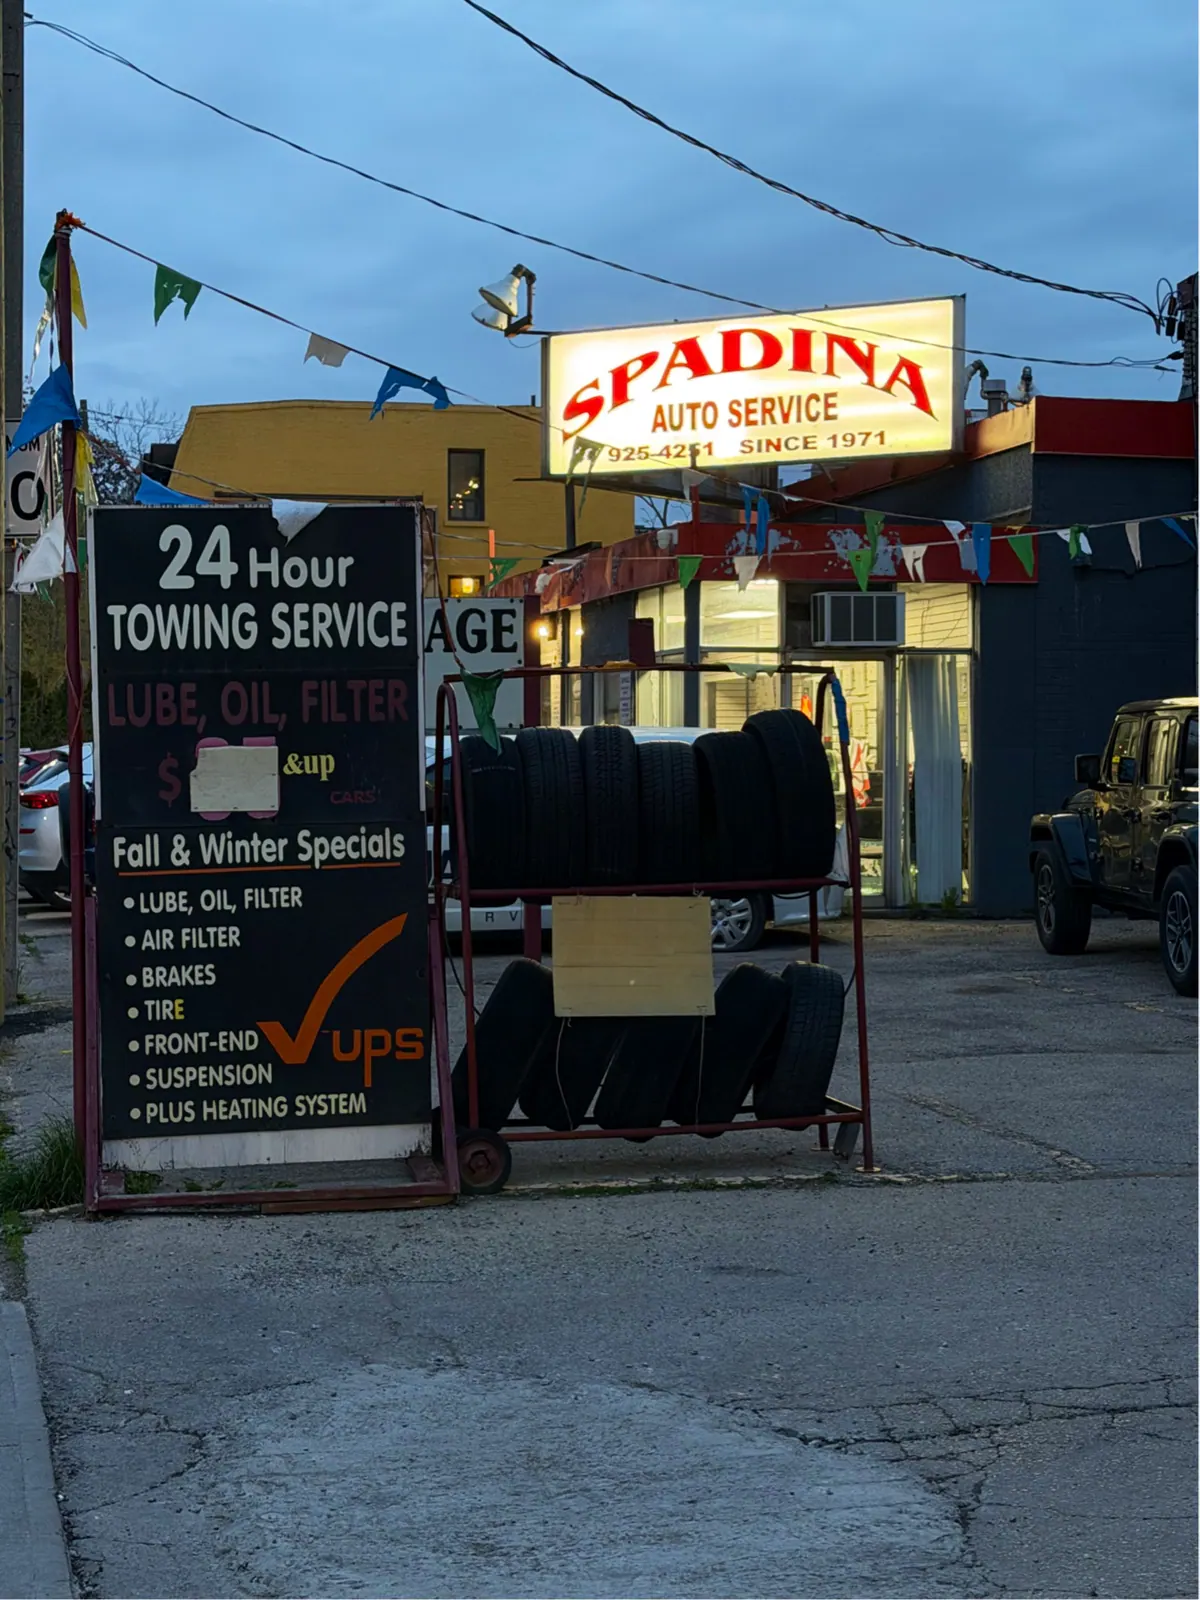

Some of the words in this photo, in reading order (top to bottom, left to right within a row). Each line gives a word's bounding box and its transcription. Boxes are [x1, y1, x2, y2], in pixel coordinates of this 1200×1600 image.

[562, 328, 938, 442] SPADINA
[651, 402, 718, 433] AUTO
[727, 392, 838, 428] SERVICE
[740, 437, 817, 454] SINCE
[831, 430, 886, 449] 1971
[159, 524, 239, 590] 24
[249, 547, 354, 589] Hour
[107, 603, 258, 651] TOWING
[272, 601, 407, 648] SERVICE
[108, 682, 207, 733] LUBE,
[221, 681, 287, 731] OIL,
[302, 679, 409, 723] FILTER
[330, 790, 377, 805] CARS
[113, 833, 160, 868] Fall
[170, 833, 190, 866] &
[199, 831, 288, 865] Winter
[298, 826, 405, 869] Specials
[140, 891, 194, 916] LUBE,
[200, 889, 237, 914] OIL,
[244, 887, 303, 909] FILTER
[141, 929, 174, 951] AIR
[181, 926, 241, 949] FILTER
[142, 964, 217, 988] BRAKES
[144, 999, 185, 1021] TIRE
[145, 1030, 259, 1055] FRONT-END
[146, 1063, 273, 1090] SUSPENSION
[146, 1101, 196, 1124] PLUS
[202, 1097, 289, 1121] HEATING
[294, 1092, 367, 1117] SYSTEM
